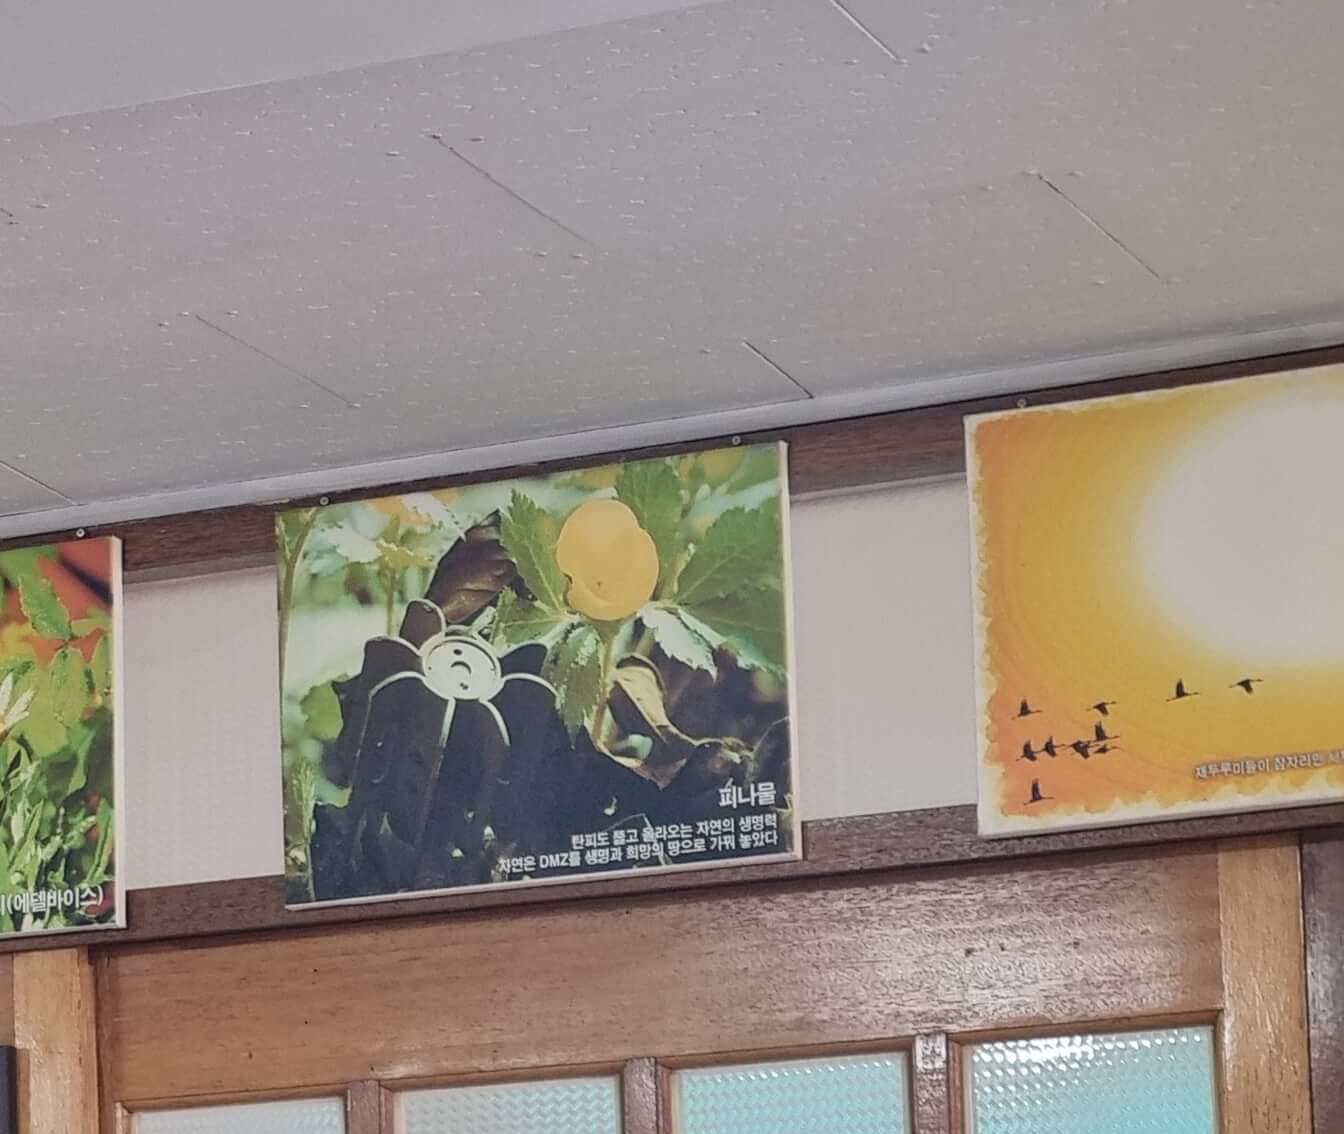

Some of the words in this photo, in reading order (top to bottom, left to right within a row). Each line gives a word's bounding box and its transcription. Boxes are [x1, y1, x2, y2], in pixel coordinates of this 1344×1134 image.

[718, 782, 776, 808] 피나물
[572, 831, 610, 850] 탄피도
[642, 823, 692, 843] 올라오는
[696, 818, 735, 837] 자연의
[739, 813, 777, 832] 생명력
[498, 856, 536, 873] 자연은
[539, 850, 581, 869] DMZ를
[585, 847, 623, 865] 생명과
[626, 841, 664, 861] 희망의
[667, 838, 707, 857] 땅으로
[739, 830, 778, 849] 놓았다
